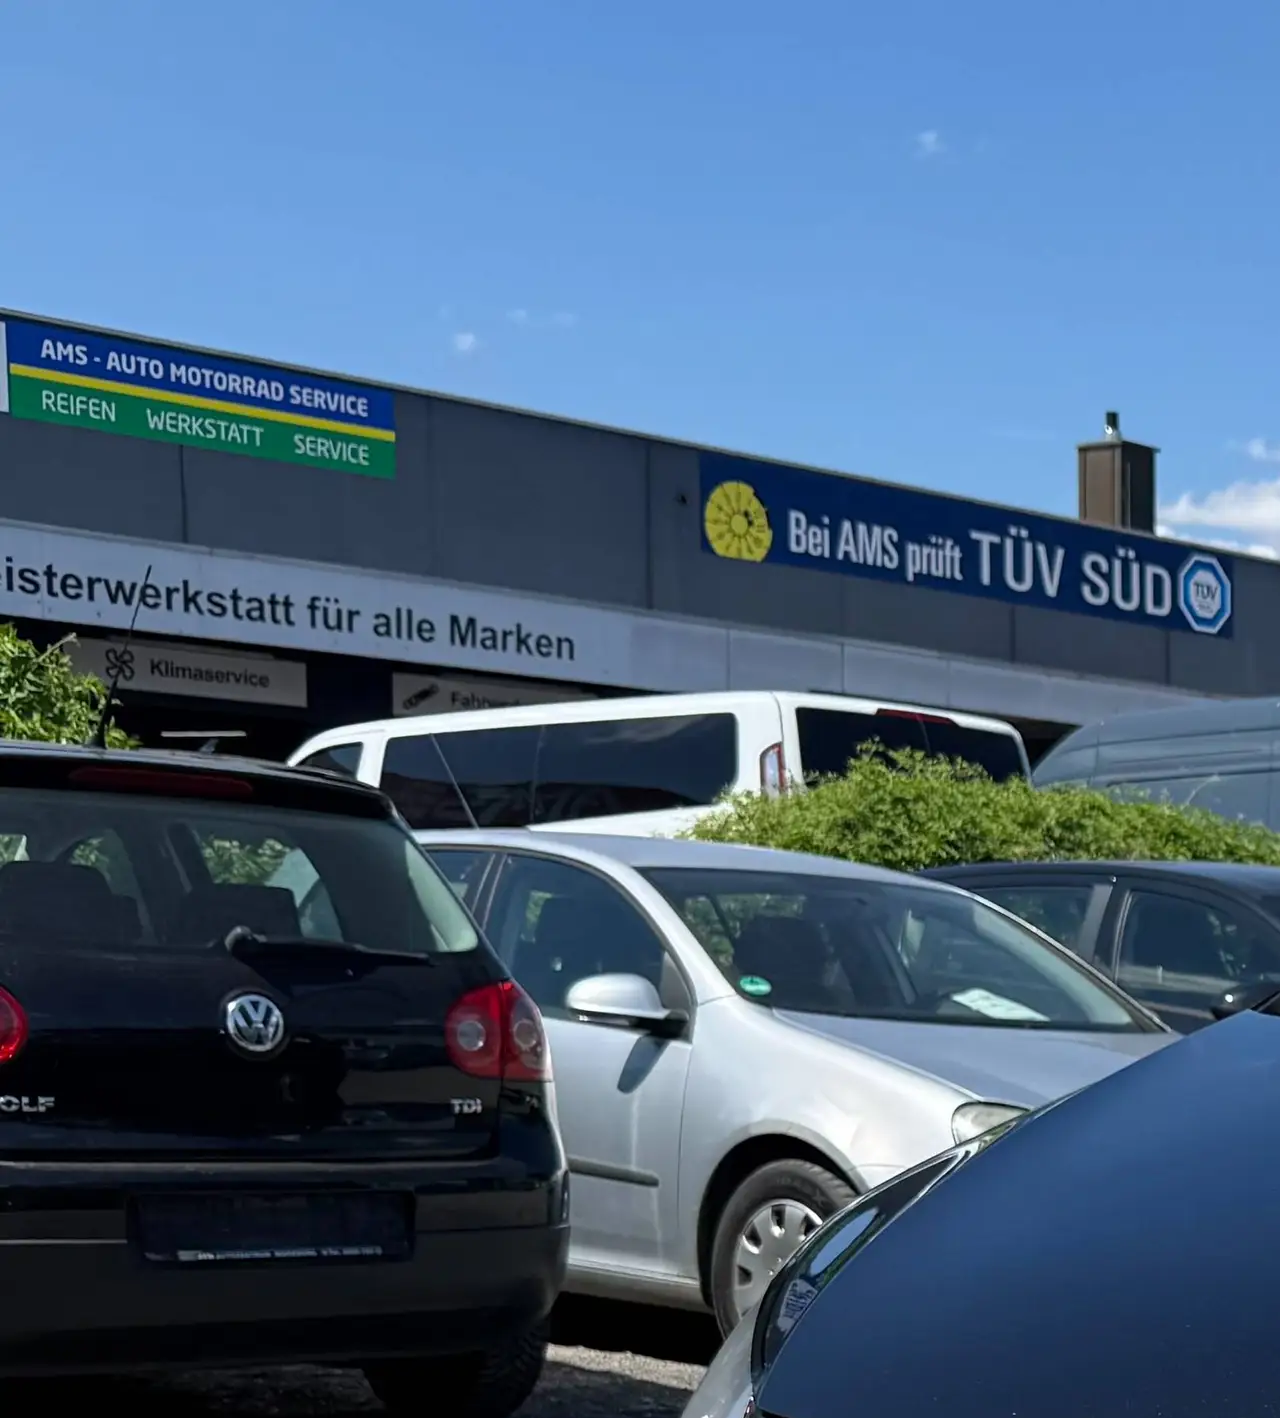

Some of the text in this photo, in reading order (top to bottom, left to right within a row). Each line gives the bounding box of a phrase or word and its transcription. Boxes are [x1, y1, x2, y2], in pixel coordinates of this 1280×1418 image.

[40, 338, 88, 366] AMS
[106, 351, 164, 379] AUTO
[170, 362, 284, 402] MOTORRAD
[289, 385, 369, 418] SERVICE
[42, 390, 370, 466] REIFEN WERKSTATT SERVICE
[789, 508, 1173, 618] Bei AMS prüft TÜV SÜD
[0, 556, 576, 661] isterwerkstatt für alle Marken
[150, 658, 270, 688] Klimaservice
[450, 1097, 482, 1114] TDI
